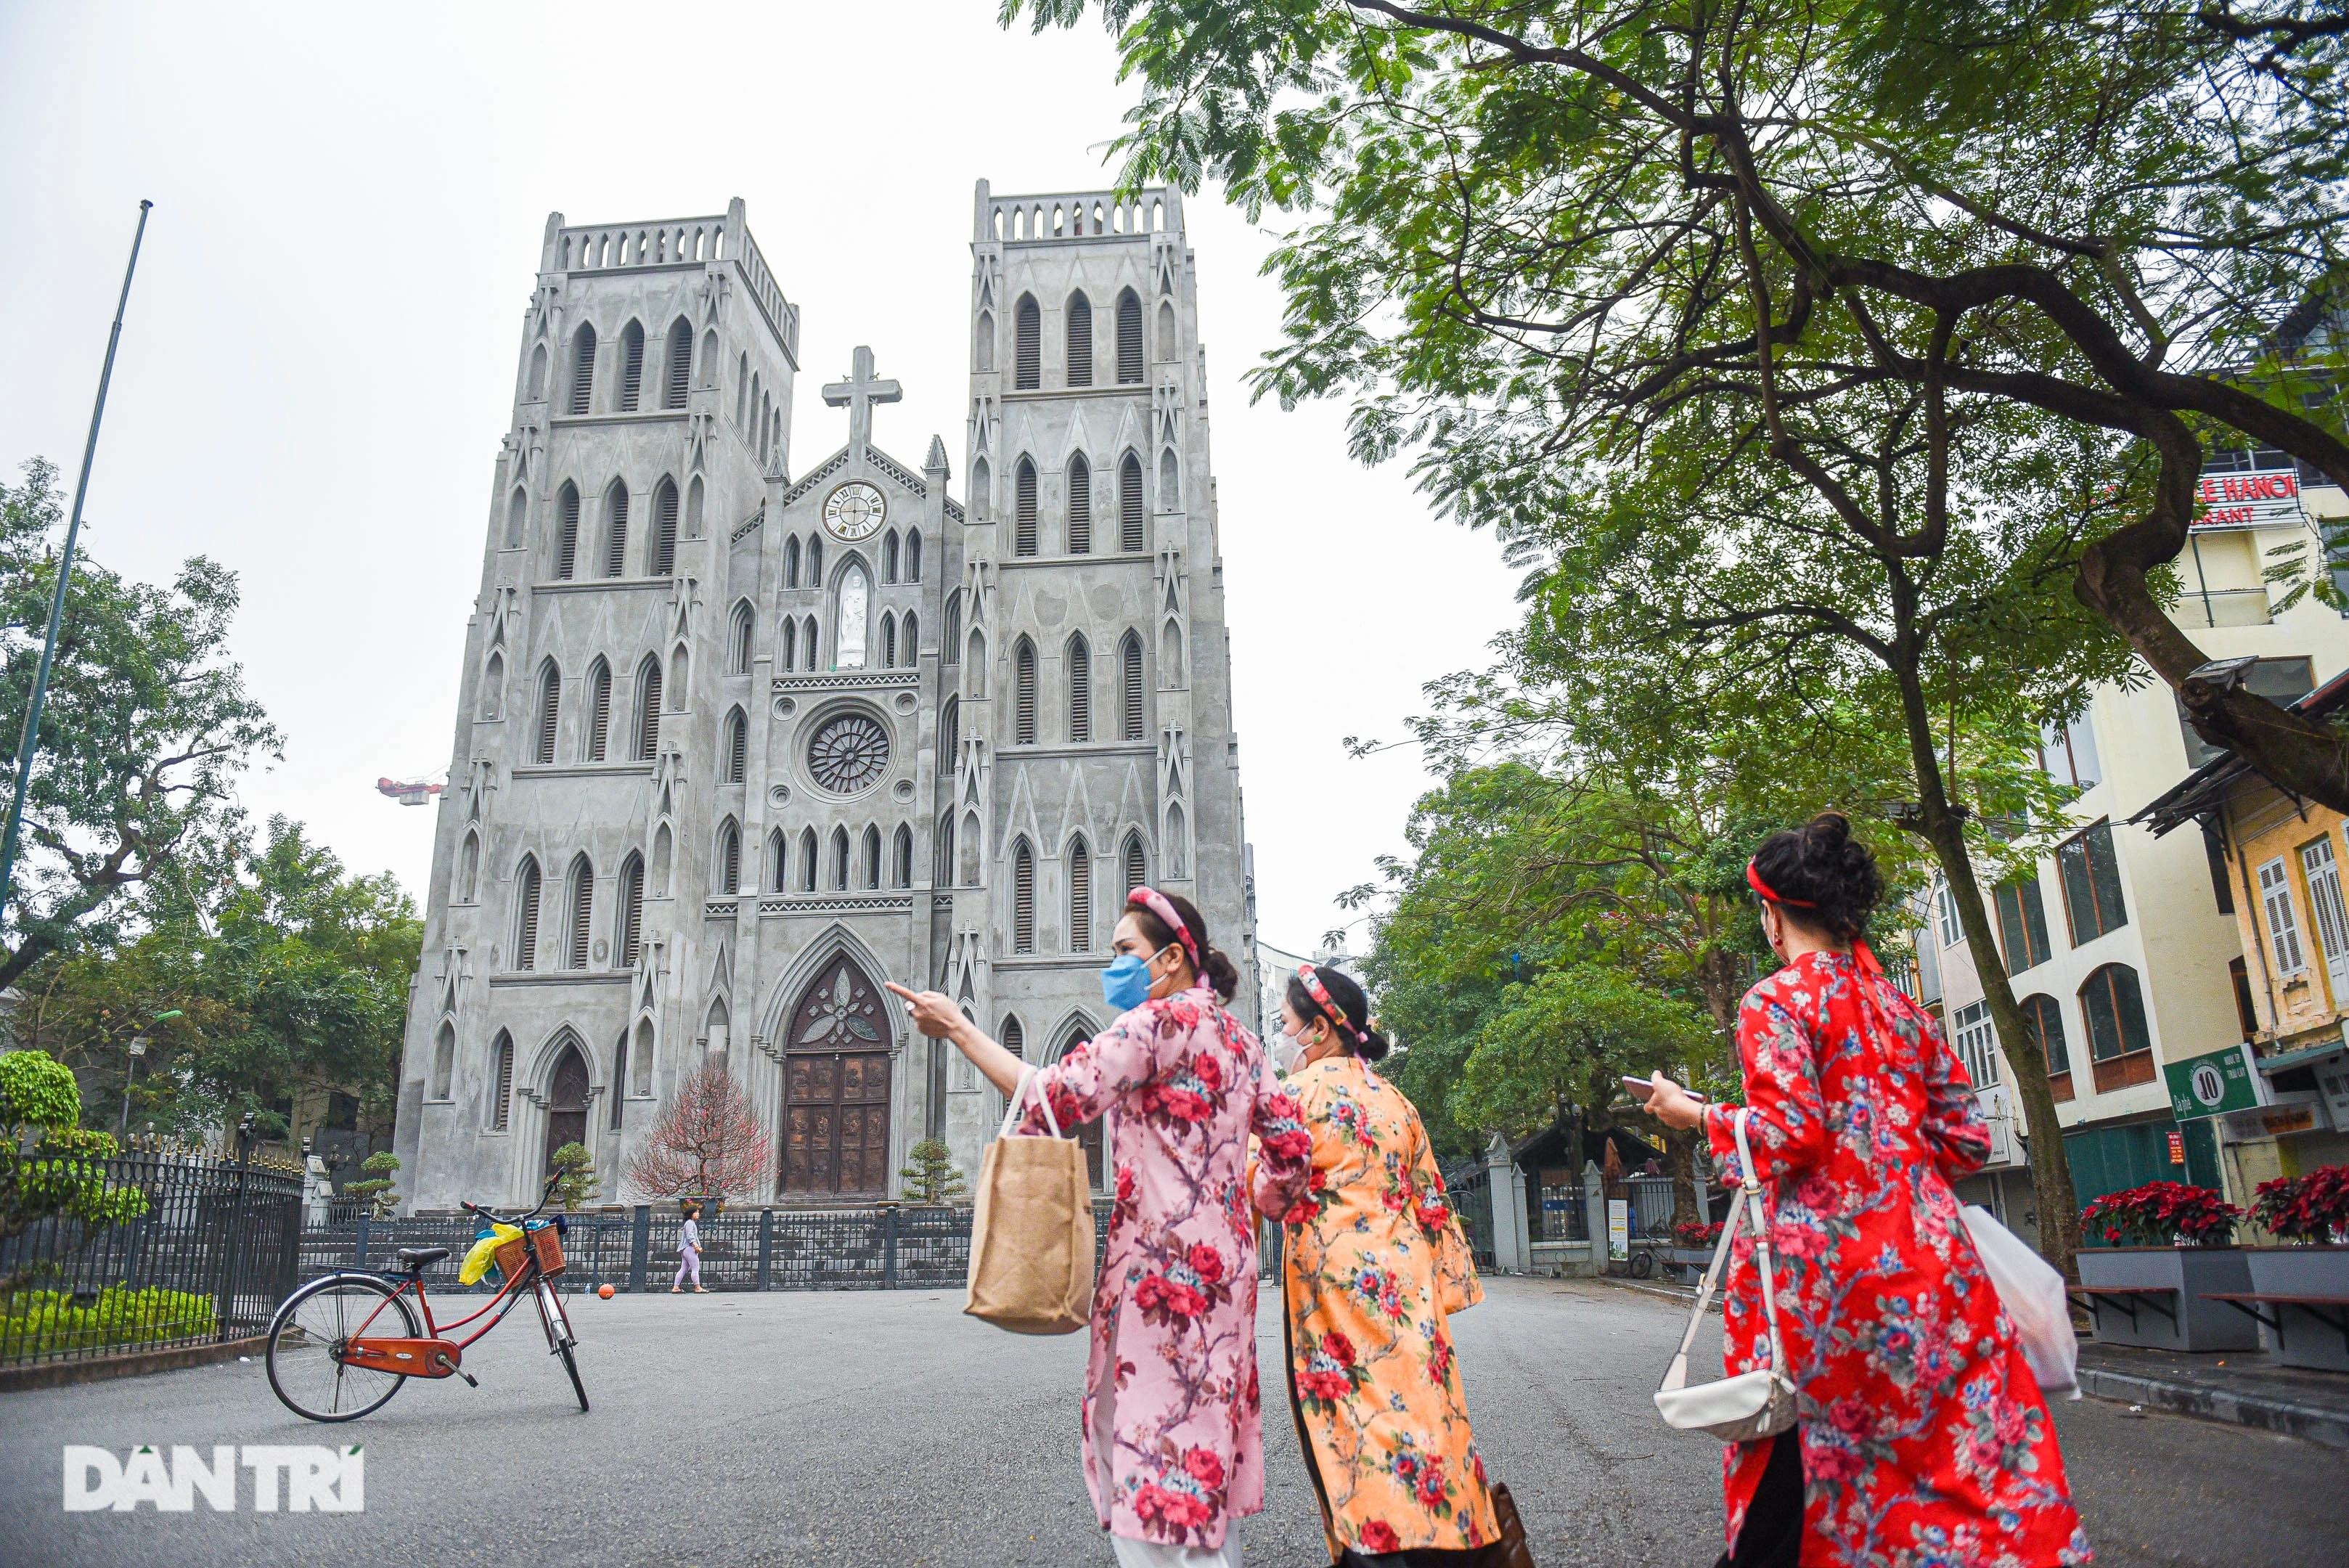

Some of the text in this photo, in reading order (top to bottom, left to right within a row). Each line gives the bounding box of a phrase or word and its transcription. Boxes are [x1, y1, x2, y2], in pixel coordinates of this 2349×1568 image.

[2223, 475, 2297, 502] HANOI
[2190, 507, 2253, 525] RANT
[2198, 1071, 2218, 1101] 10
